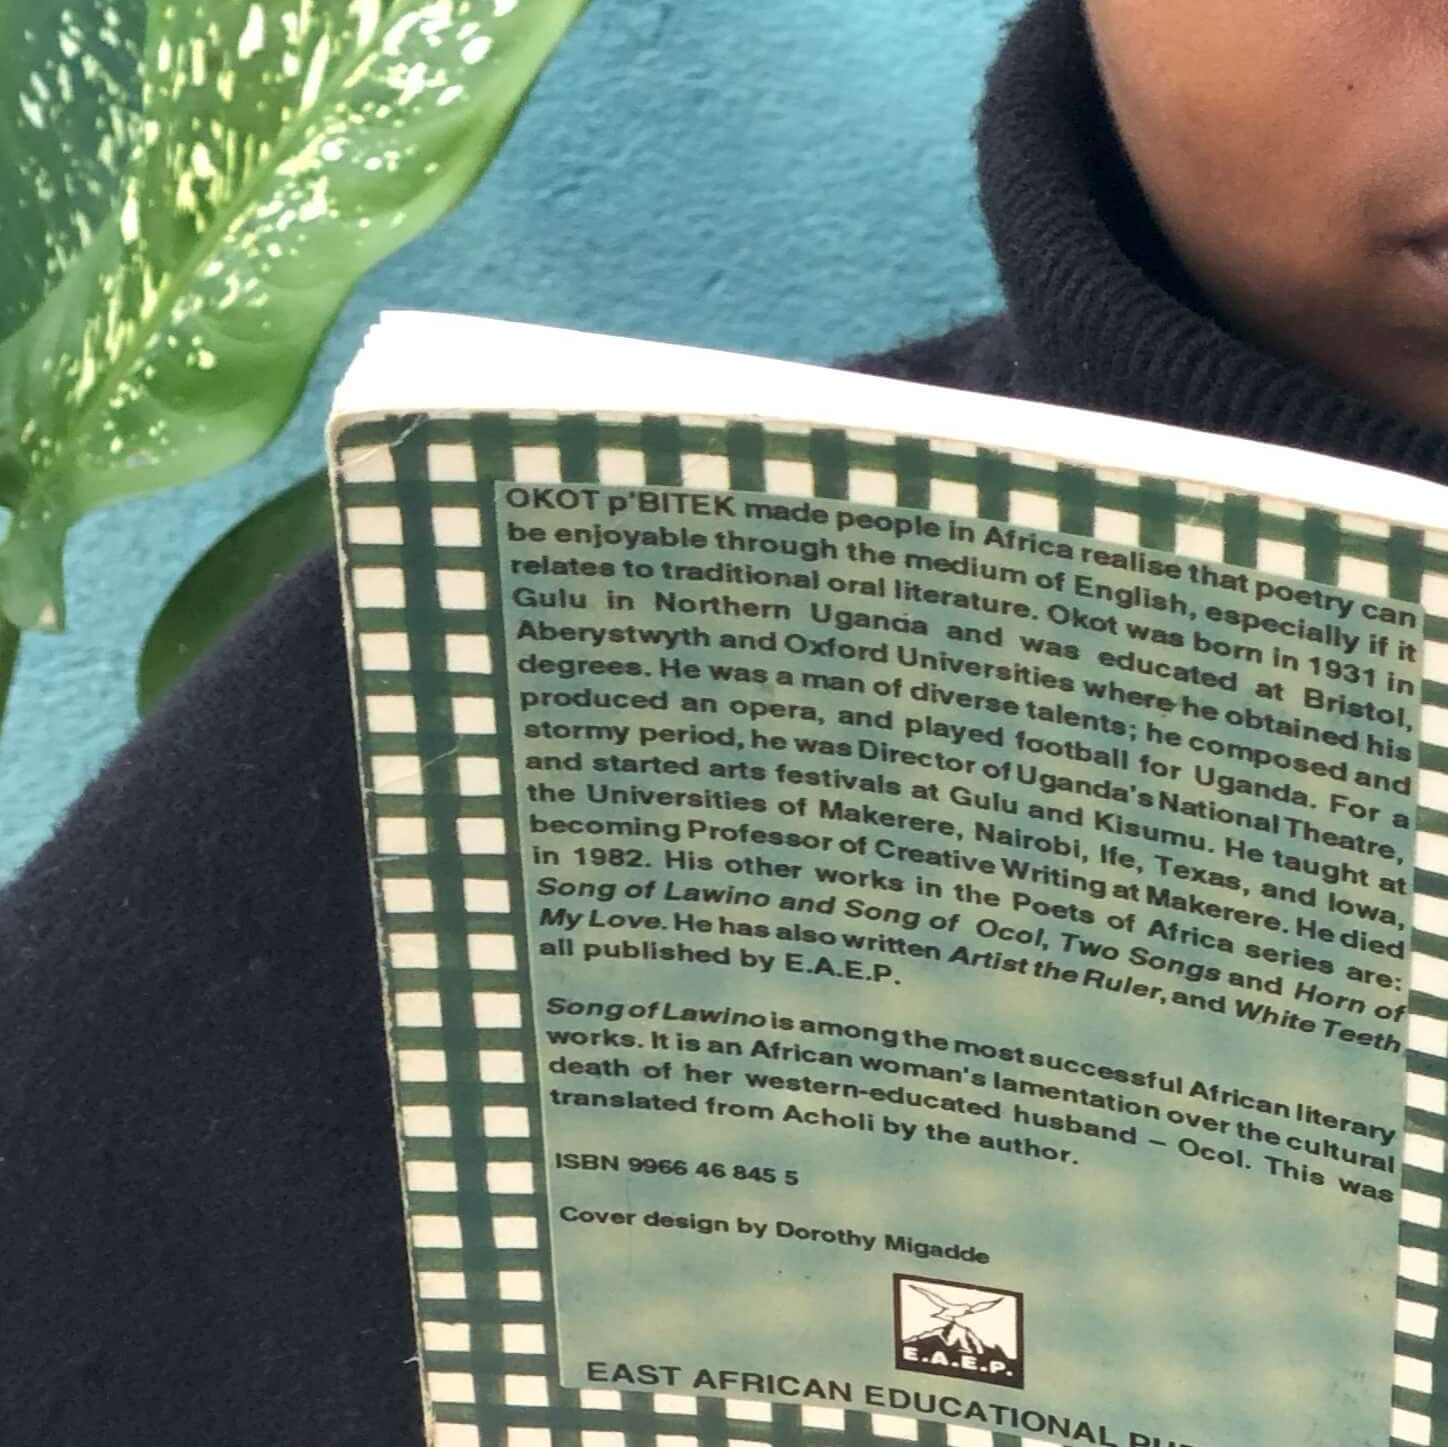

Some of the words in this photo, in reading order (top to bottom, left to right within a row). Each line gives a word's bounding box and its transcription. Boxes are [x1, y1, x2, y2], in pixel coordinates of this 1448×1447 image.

[504, 486, 601, 511] OKOT
[744, 501, 829, 525] made
[835, 510, 942, 539] people
[948, 516, 976, 545] in
[983, 526, 1075, 560] Africa
[1080, 547, 1183, 580] realise
[1187, 562, 1249, 594] that
[1255, 580, 1355, 620] poetry
[1360, 603, 1418, 629] can
[506, 520, 547, 543] be
[553, 524, 709, 550] enjoyable
[713, 530, 839, 563] through
[845, 541, 897, 567] the
[903, 553, 1028, 585] medium
[1034, 571, 1066, 593] of
[1074, 574, 1198, 620] English,
[1204, 606, 1361, 654] especially
[1368, 632, 1389, 658] if
[1397, 639, 1417, 664] it
[510, 555, 616, 578] relates
[621, 559, 655, 580] to
[660, 562, 820, 590] traditional
[826, 576, 886, 598] oral
[894, 579, 1039, 620] literature.
[1046, 603, 1118, 635] Okot
[1125, 622, 1185, 648] was
[1192, 630, 1264, 664] born
[1272, 645, 1300, 672] in
[1308, 656, 1376, 688] 1931
[1386, 670, 1415, 697] in
[516, 654, 652, 680] degrees.
[659, 656, 702, 680] He
[707, 664, 769, 688] was
[775, 669, 794, 687] a
[801, 672, 866, 694] man
[872, 676, 903, 699] of
[909, 682, 1021, 716] diverse
[1025, 701, 1137, 742] talents;
[1145, 720, 1183, 748] he
[1187, 736, 1349, 782] composed
[1353, 770, 1412, 797] and
[519, 688, 669, 712] produced
[680, 695, 718, 714] an
[728, 699, 825, 726] opera,
[837, 709, 894, 731] and
[904, 716, 1005, 748] played
[1014, 730, 1129, 770] football
[1138, 753, 1183, 781] for
[1194, 765, 1317, 809] Uganda.
[1329, 792, 1382, 823] For
[1391, 811, 1410, 831] a
[524, 751, 583, 773] and
[592, 754, 700, 777] started
[708, 761, 767, 782] arts
[774, 763, 902, 796] festivals
[910, 783, 940, 803] at
[949, 785, 1019, 815] Gulu
[1027, 803, 1084, 827] and
[1093, 810, 1215, 853] Kisumu.
[1224, 836, 1265, 864] He
[1271, 850, 1369, 887] taught
[1377, 876, 1408, 897] at
[525, 782, 576, 804] the
[586, 783, 768, 813] Universities
[777, 796, 808, 818] of
[818, 799, 964, 840] Makerere,
[974, 821, 1089, 863] Nairobi,
[1153, 854, 1251, 896] Texas,
[1260, 882, 1317, 908] and
[1327, 891, 1406, 932] Iowa,
[528, 814, 682, 843] becoming
[687, 819, 834, 851] Professor
[837, 835, 868, 857] of
[874, 838, 997, 875] Creative
[1000, 858, 1107, 900] Writing
[1111, 882, 1140, 903] at
[1145, 885, 1289, 933] Makerere.
[1295, 916, 1336, 944] He
[1339, 929, 1405, 961] died
[532, 844, 560, 866] in
[573, 846, 653, 869] 1982.
[664, 849, 714, 872] His
[724, 856, 803, 880] other
[813, 867, 905, 893] works
[916, 874, 943, 899] in
[953, 882, 1001, 908] the
[1012, 891, 1096, 925] Poets
[1106, 912, 1137, 934] of
[1146, 919, 1234, 954] Africa
[1244, 943, 1335, 975] series
[1345, 965, 1403, 993] are:
[535, 875, 617, 903] Song
[623, 879, 657, 901] of
[663, 880, 771, 908] Lawino
[778, 895, 837, 916] and
[843, 897, 921, 931] Song
[928, 912, 961, 933] of
[975, 917, 1049, 952] Ocol,
[1060, 931, 1120, 962] Two
[1127, 946, 1223, 983] Songs
[1227, 971, 1284, 997] and
[1293, 981, 1367, 1014] Horn
[1373, 1004, 1405, 1024] of
[538, 936, 575, 957] all
[583, 940, 732, 965] published
[739, 947, 776, 974] by
[784, 952, 901, 985] E.A.E.P.
[544, 1028, 644, 1049] works.
[650, 1029, 670, 1051] It
[675, 1031, 702, 1053] is
[706, 1039, 744, 1057] an
[749, 1039, 854, 1069] African
[858, 1055, 987, 1087] woman's
[993, 1072, 1161, 1120] lamentation
[1166, 1109, 1232, 1135] over
[1235, 1120, 1281, 1146] the
[1285, 1135, 1396, 1174] cultural
[548, 1056, 631, 1079] death
[642, 1060, 673, 1081] of
[683, 1062, 734, 1085] her
[744, 1073, 1002, 1119] western-educated
[1013, 1104, 1137, 1145] husband
[1177, 1137, 1252, 1170] Ocol.
[1263, 1154, 1326, 1187] This
[1337, 1177, 1395, 1204] was
[554, 1152, 620, 1172] ISBN
[627, 1156, 689, 1177] 9966
[695, 1160, 727, 1180] 46
[731, 1163, 777, 1185] 845
[783, 1168, 800, 1188] 5
[559, 1205, 637, 1226] Cover
[642, 1210, 730, 1235] design
[736, 1216, 769, 1240] by
[775, 1220, 877, 1252] Dorothy
[883, 1233, 991, 1265] Migadde
[585, 1360, 682, 1387] EAST
[692, 1368, 854, 1403] AFRICAN
[864, 1384, 1119, 1447] EDUCATIONAL
[902, 1346, 1014, 1378] E.A.E.P.
